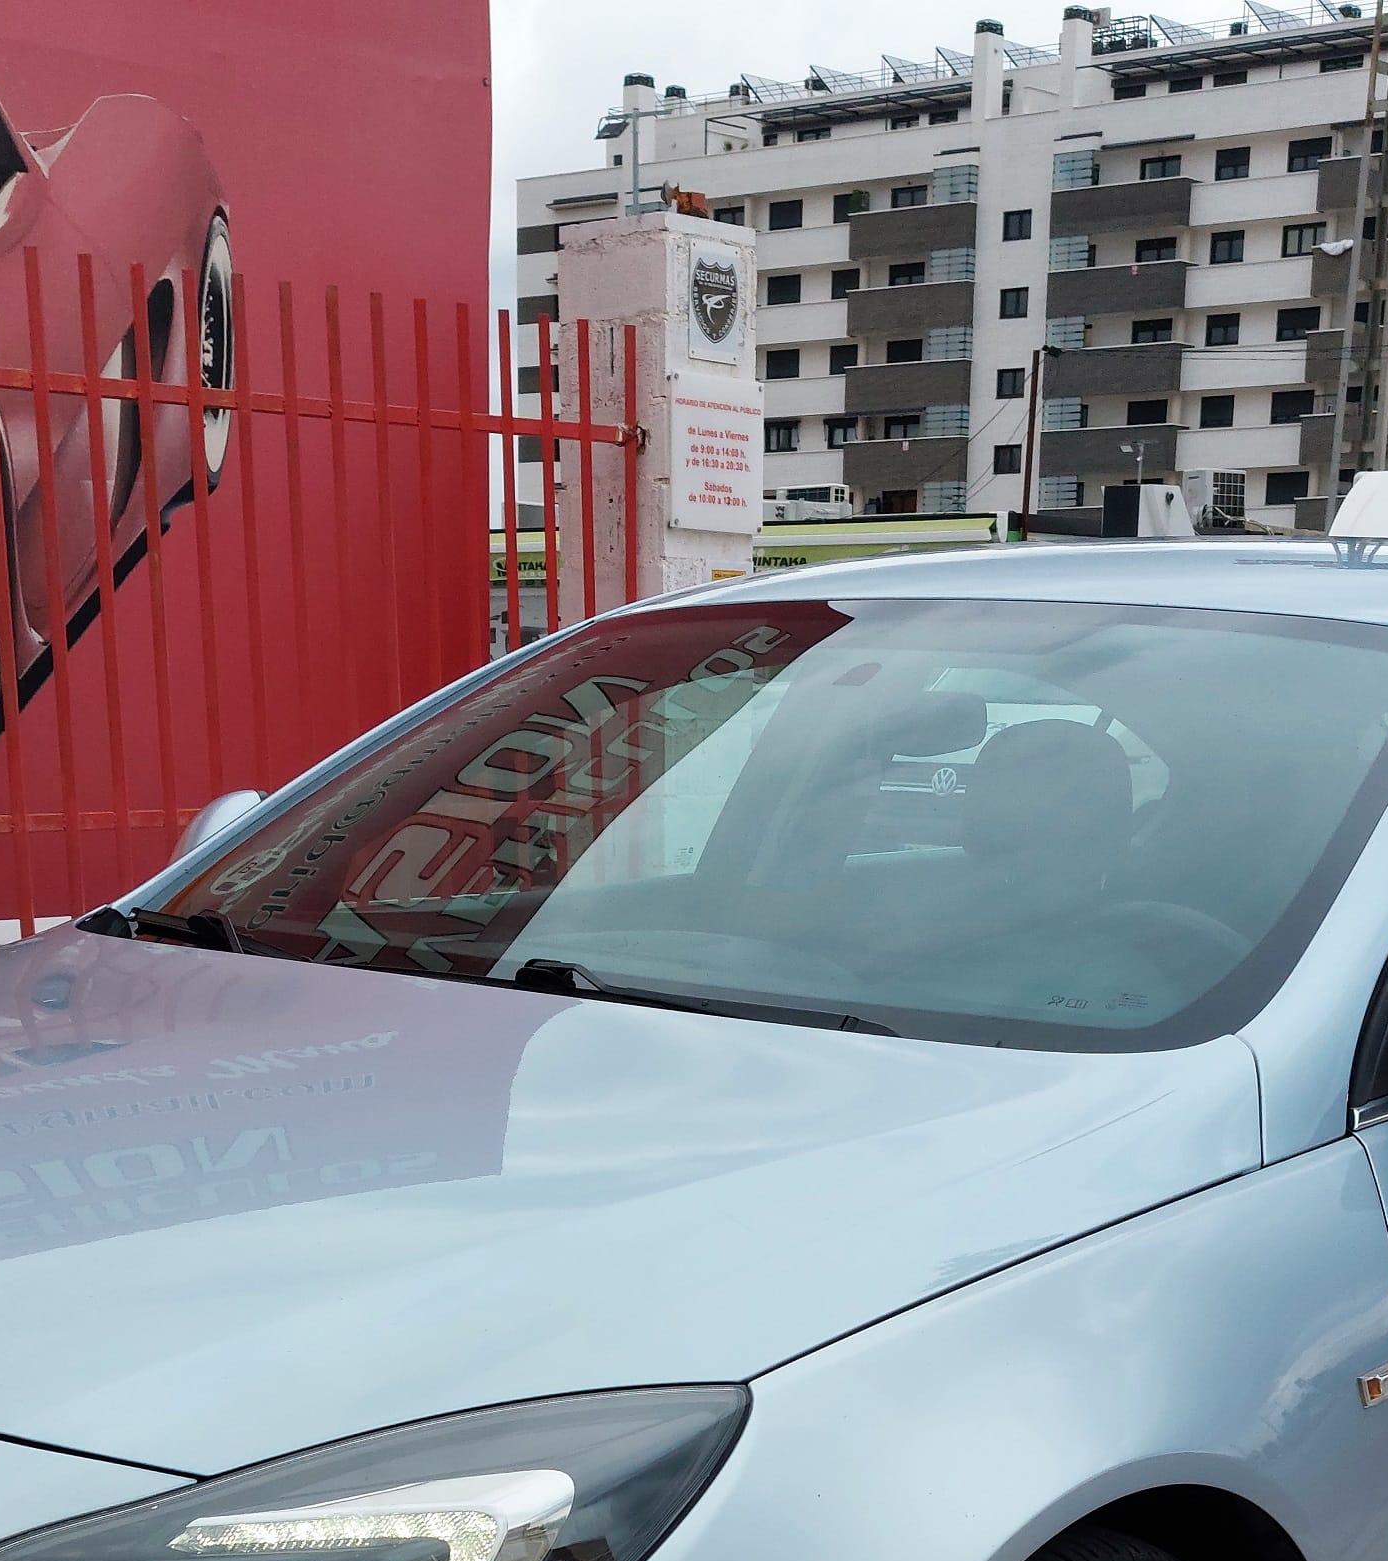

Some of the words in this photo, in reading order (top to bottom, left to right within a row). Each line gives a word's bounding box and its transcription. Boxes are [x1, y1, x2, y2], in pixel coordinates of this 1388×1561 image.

[695, 269, 735, 287] SECURMAS
[699, 400, 706, 408] DE
[688, 426, 696, 435] de
[697, 426, 718, 438] Lunes
[719, 431, 724, 439] a
[725, 429, 749, 442] Viernes
[690, 444, 699, 453] de
[716, 448, 720, 456] a
[685, 458, 691, 468] y
[692, 457, 700, 467] de
[688, 493, 697, 502] de
[717, 497, 722, 505] a
